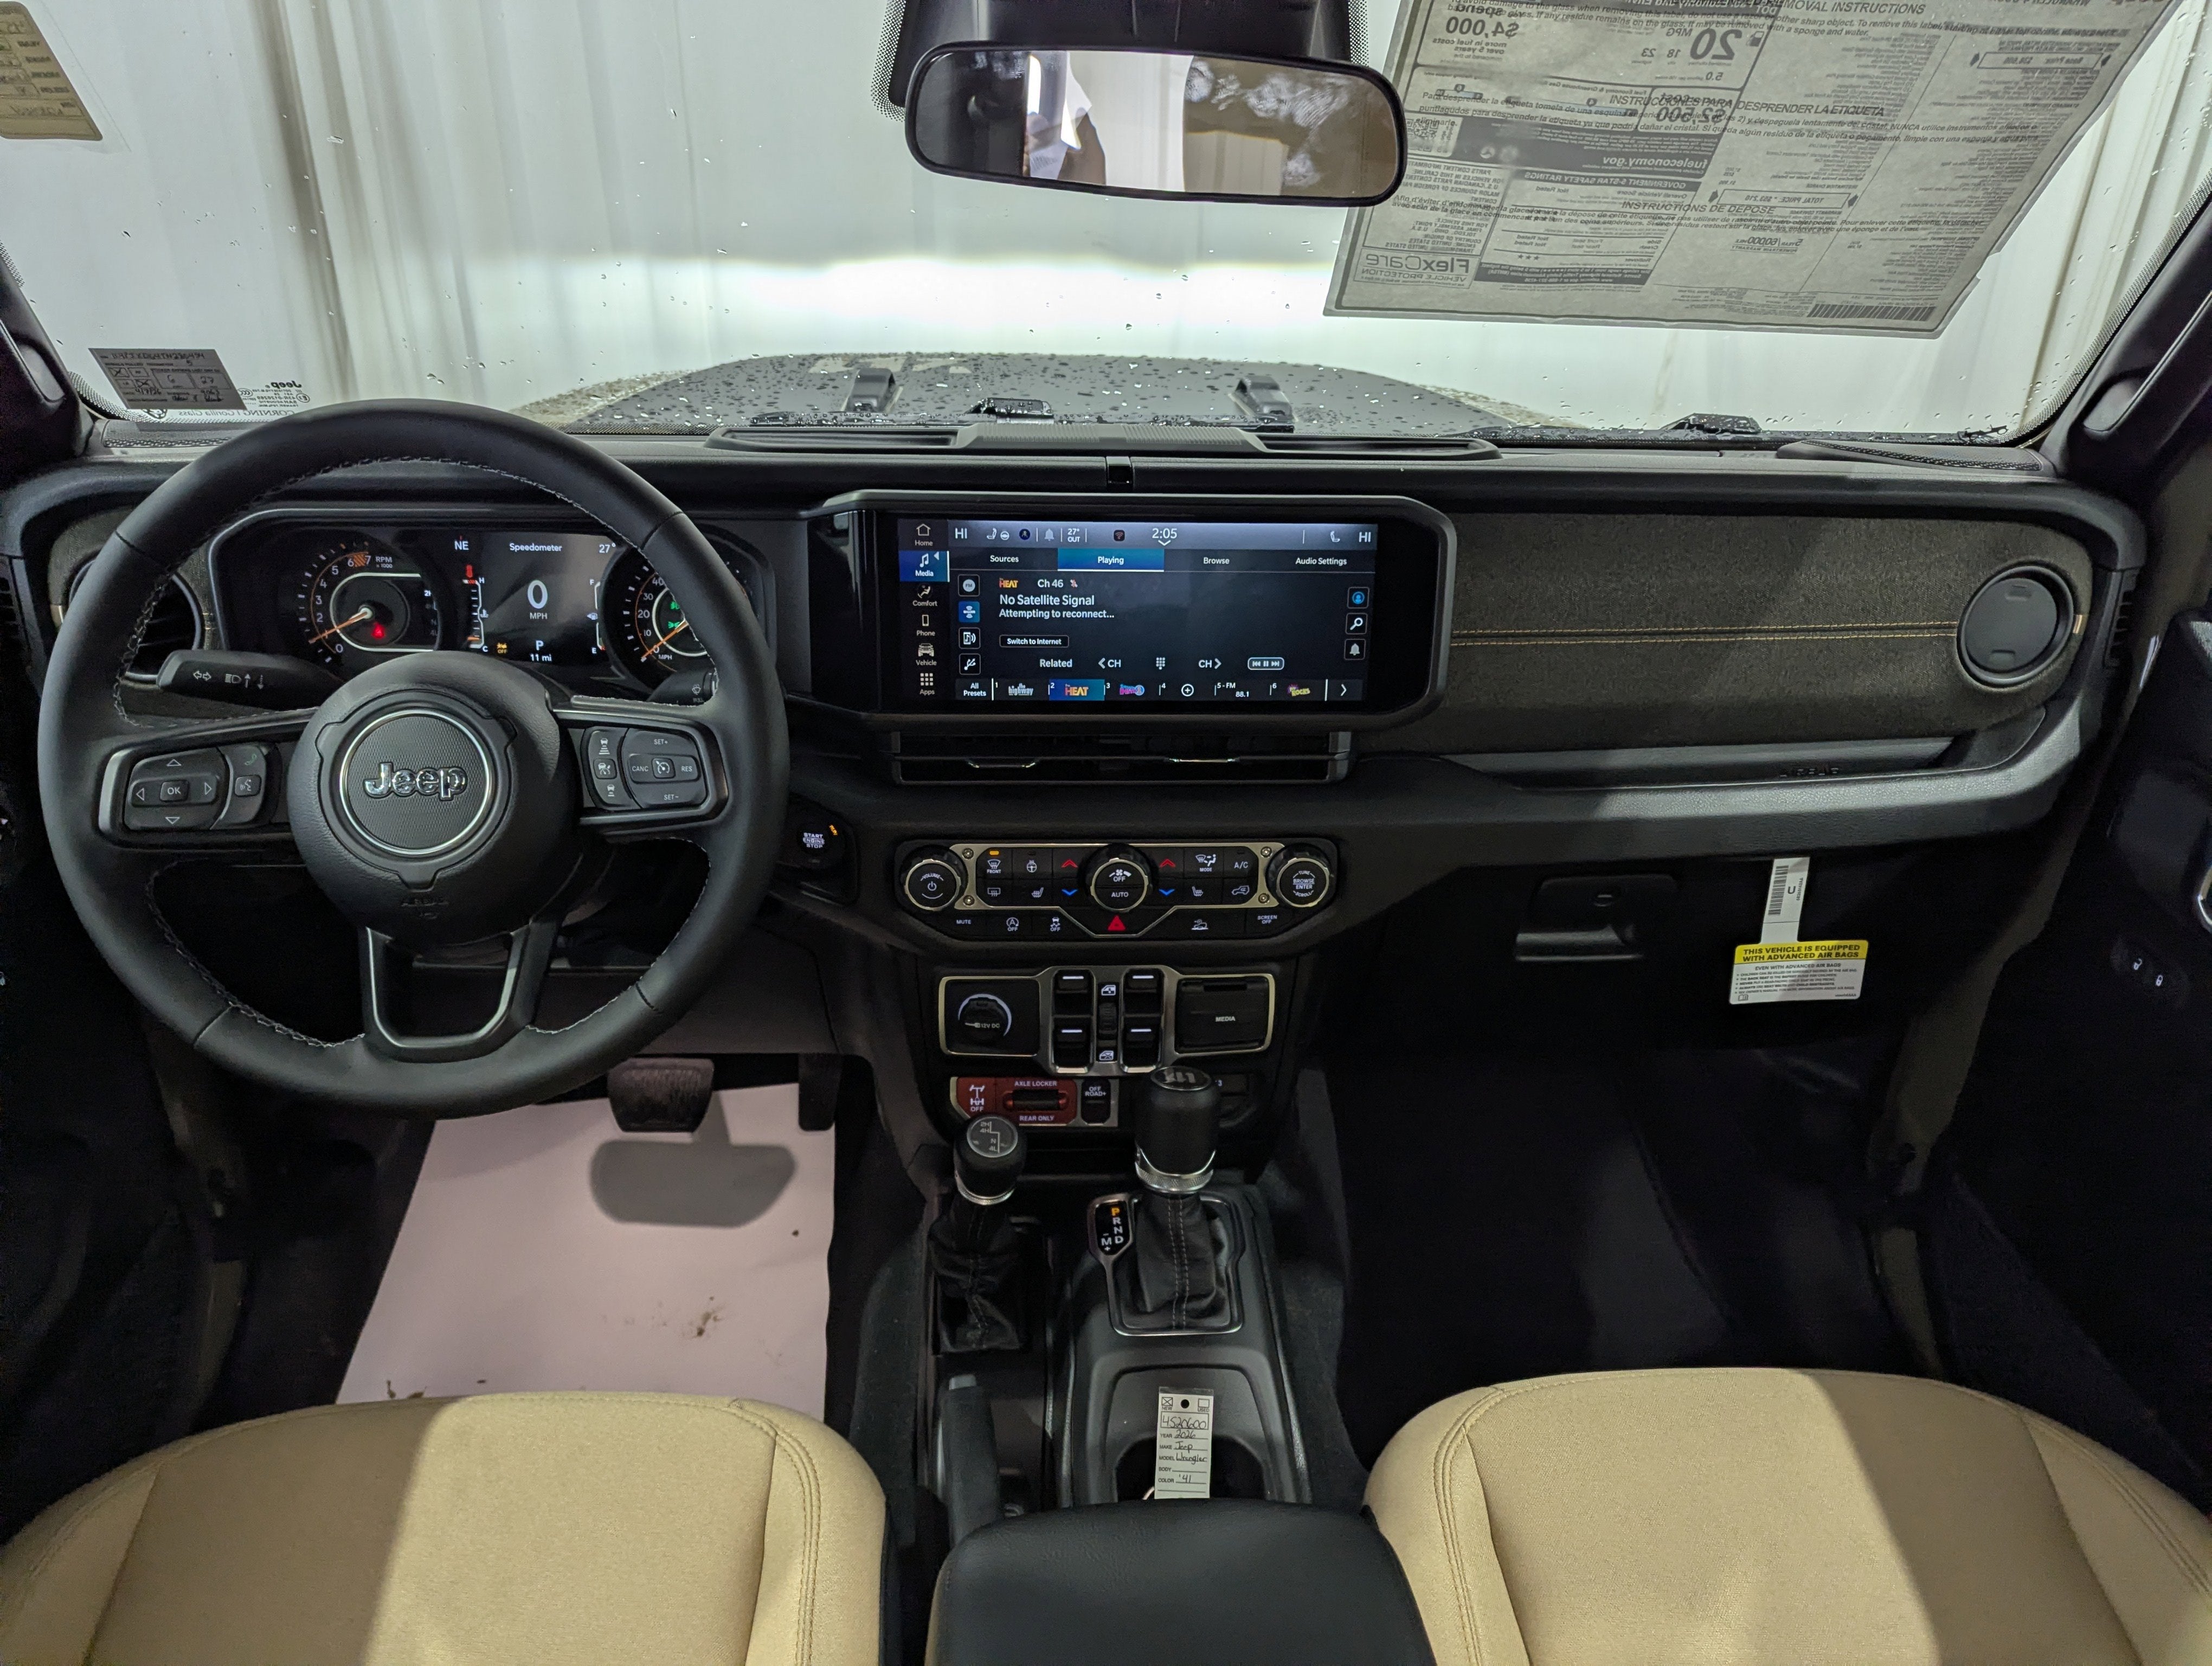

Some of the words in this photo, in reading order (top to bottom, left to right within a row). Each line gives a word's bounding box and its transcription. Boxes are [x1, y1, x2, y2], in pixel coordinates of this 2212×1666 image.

[955, 528, 967, 539] HI
[1152, 528, 1177, 539] 2:05
[1359, 532, 1371, 542] HI
[454, 541, 469, 550] NE
[510, 543, 562, 552] Speedometer
[1098, 556, 1124, 565] Playing
[1318, 558, 1347, 566] Settings
[332, 566, 338, 574] 5
[320, 580, 327, 588] 4
[652, 578, 665, 586] 40
[999, 580, 1018, 588] HEAT
[528, 580, 548, 608] 0
[316, 596, 322, 605] 3
[1000, 594, 1015, 605] No
[1017, 594, 1060, 605] Satellite
[1062, 595, 1095, 607] Signal
[317, 613, 324, 621] 2
[638, 610, 650, 618] 20
[999, 610, 1050, 619] Attempting
[335, 644, 343, 652] 0
[536, 640, 543, 650] P
[1039, 659, 1072, 668] Related
[1107, 659, 1121, 668] CH
[1198, 659, 1212, 668] CH
[1065, 687, 1089, 696] HEAT
[363, 761, 467, 800] Jeep
[167, 787, 181, 795] OK
[1788, 886, 1796, 894] U
[1111, 1208, 1120, 1216] P
[1102, 1238, 1111, 1246] M
[1115, 1235, 1123, 1244] D
[1175, 1429, 1195, 1439] 2026
[1175, 1441, 1193, 1453] Jeep
